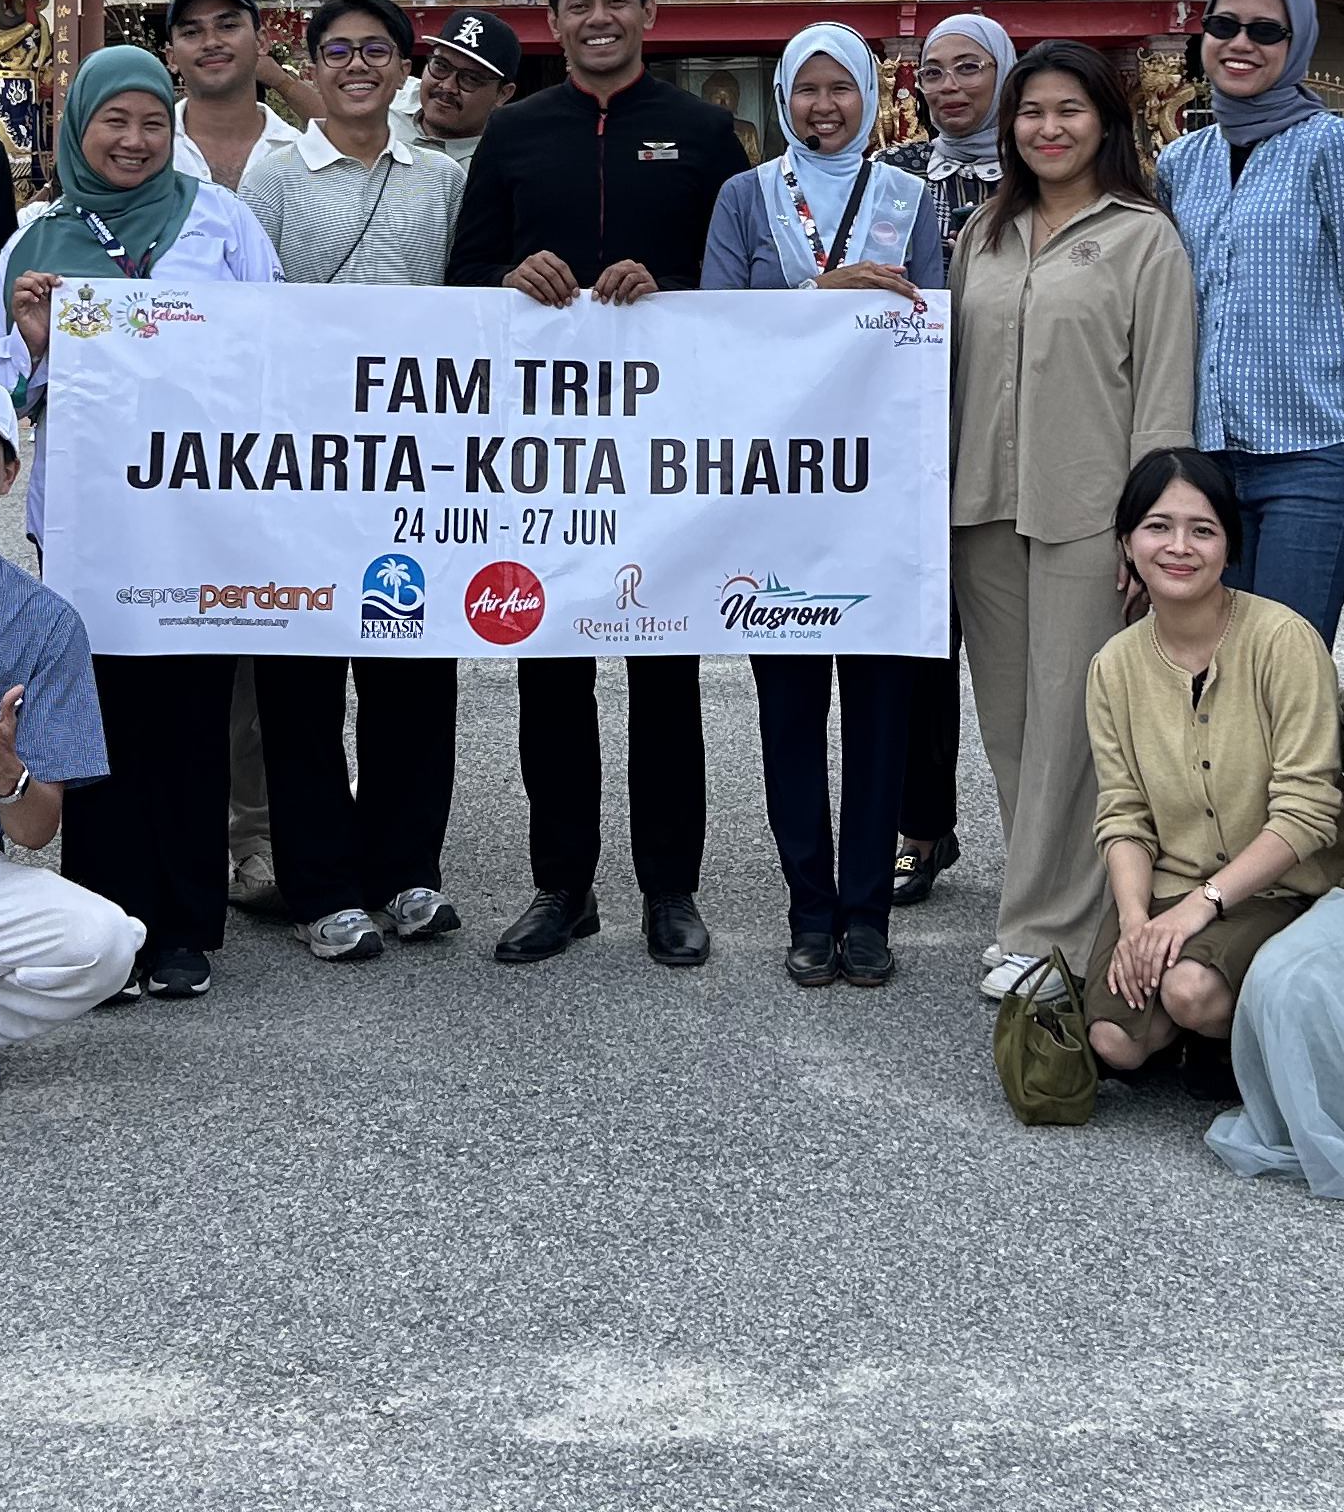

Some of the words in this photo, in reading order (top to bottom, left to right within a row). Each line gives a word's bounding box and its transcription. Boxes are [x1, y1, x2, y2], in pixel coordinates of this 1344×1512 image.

[150, 297, 194, 310] Tourism
[150, 309, 207, 323] Kelantan
[354, 355, 491, 414] FAM
[514, 359, 660, 417] TRIP
[126, 431, 626, 495] JAKARTA-KOTA
[649, 436, 870, 496] BHARU
[394, 507, 427, 544] 24
[434, 507, 490, 544] JUN
[521, 508, 554, 545] 27
[562, 508, 617, 545] JUN
[720, 592, 842, 630] Nasrom
[361, 620, 424, 633] KEMASIN
[573, 617, 631, 640] Renai
[636, 615, 689, 633] Hotel
[740, 630, 778, 639] TRAVEL
[779, 630, 787, 639] &
[788, 630, 822, 639] TOURS
[605, 634, 630, 642] Kota
[634, 634, 665, 642] Bharu
